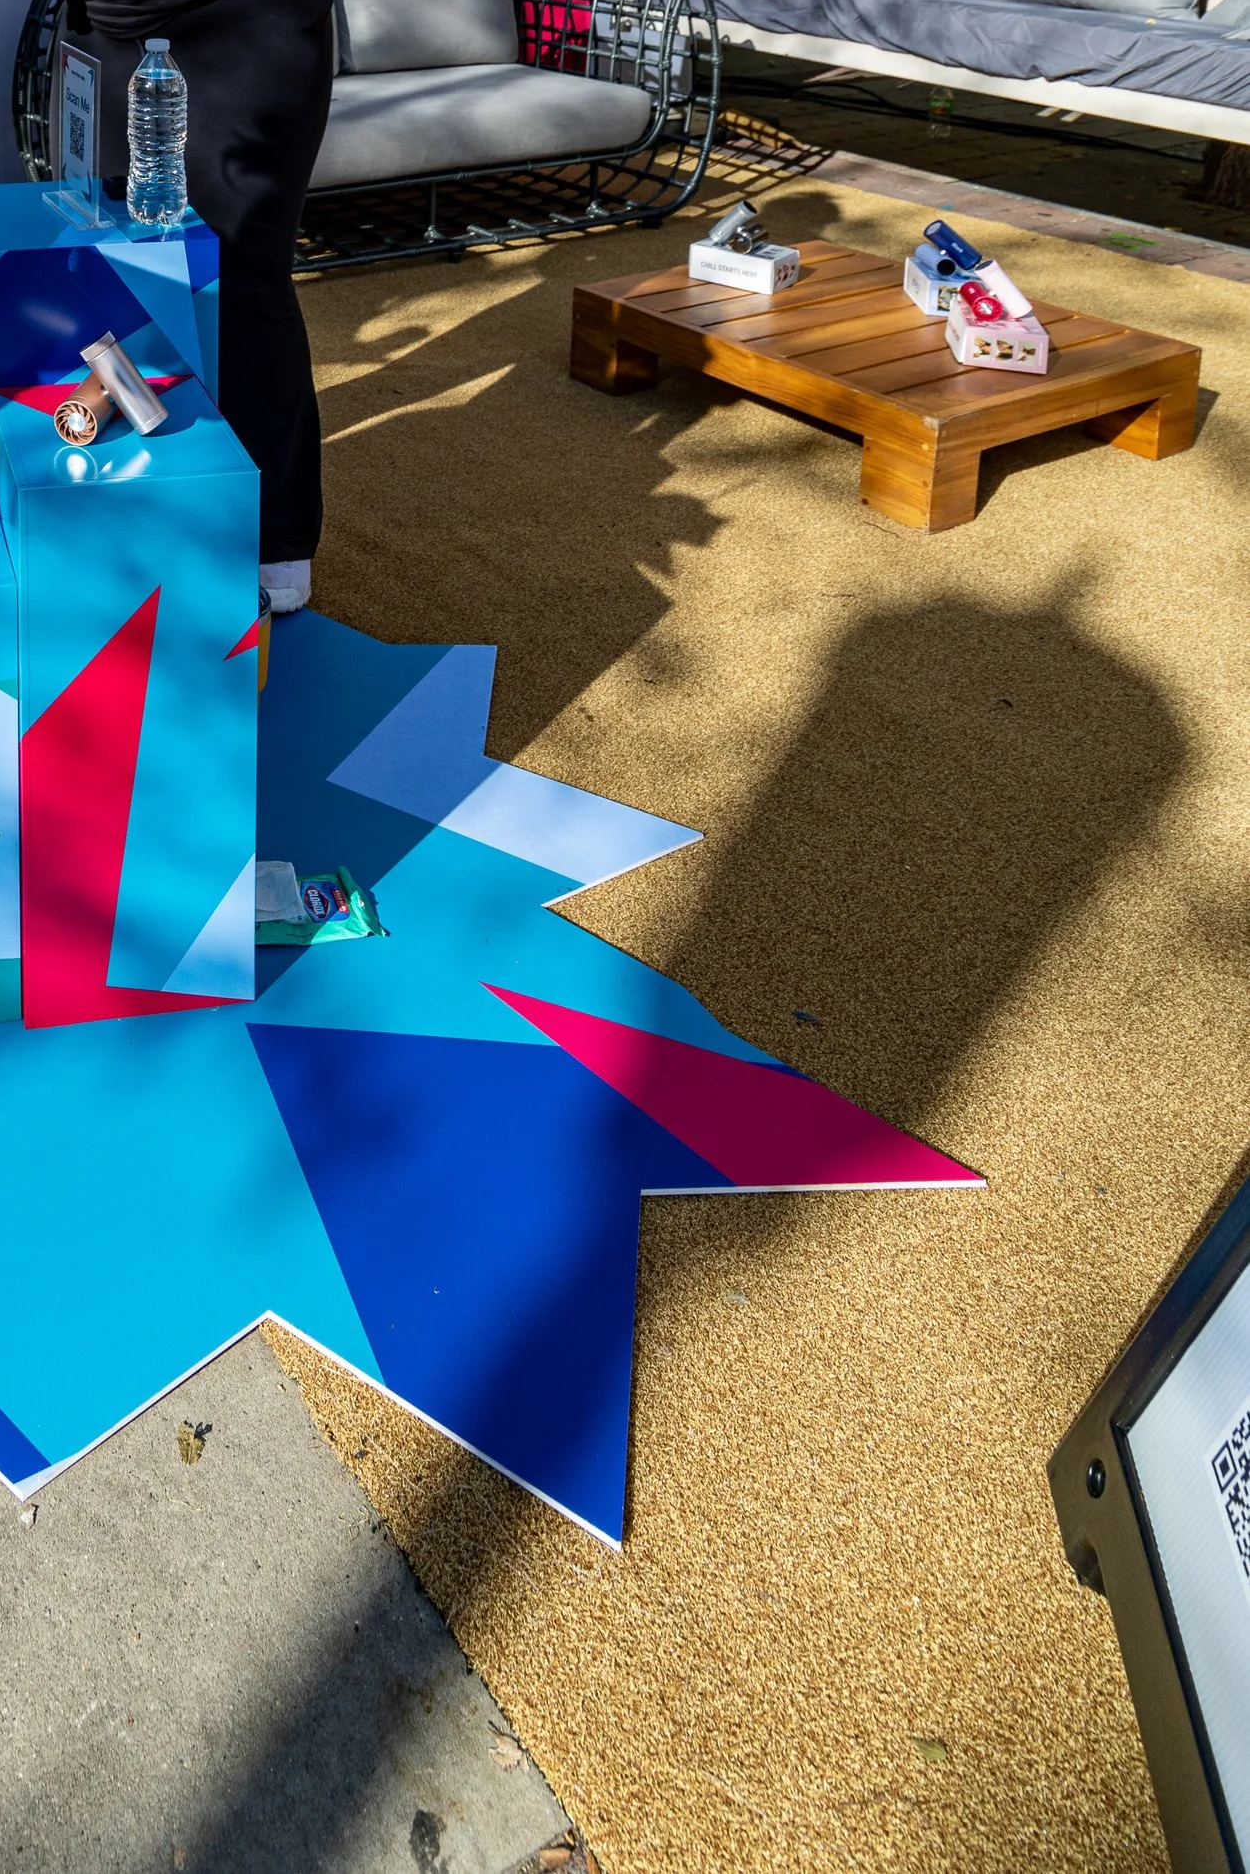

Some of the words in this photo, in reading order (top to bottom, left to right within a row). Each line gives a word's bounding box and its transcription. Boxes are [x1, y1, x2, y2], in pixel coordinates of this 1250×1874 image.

[66, 87, 80, 108] Scan
[80, 95, 90, 115] Me
[307, 889, 326, 915] CLOROX
